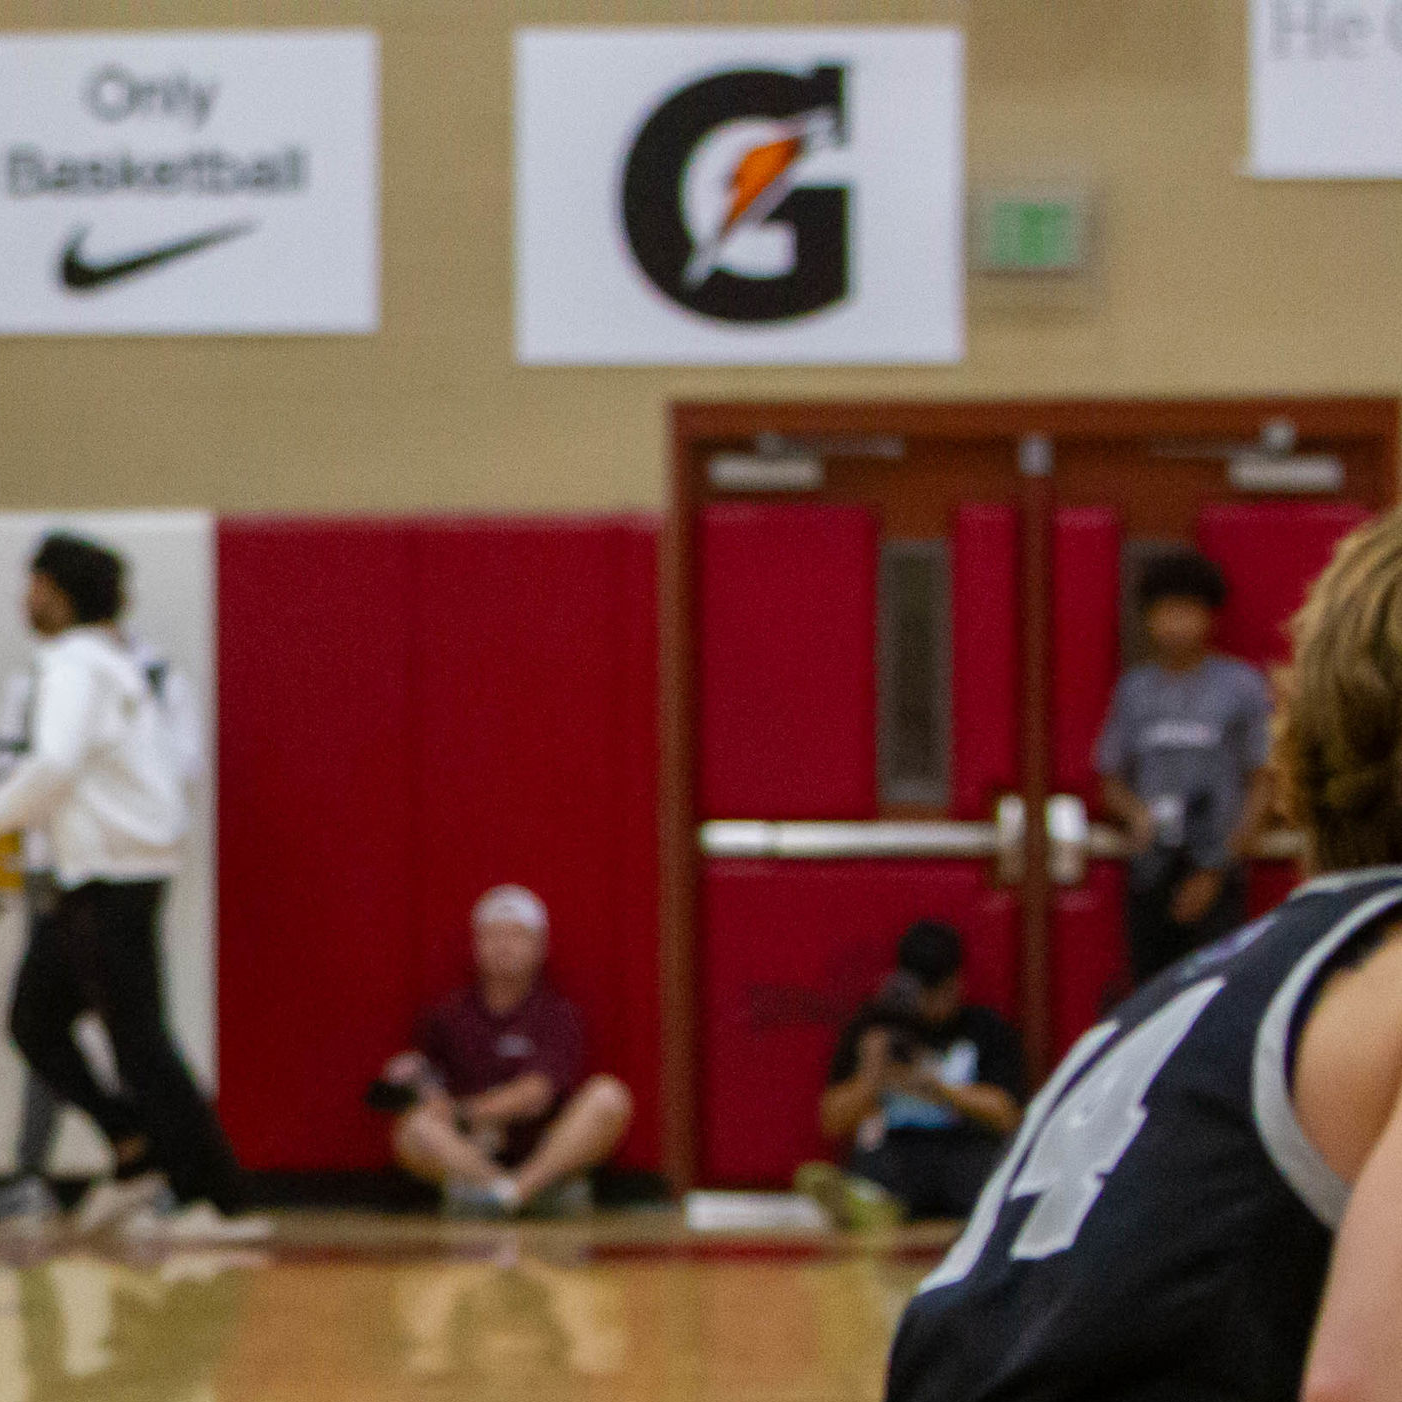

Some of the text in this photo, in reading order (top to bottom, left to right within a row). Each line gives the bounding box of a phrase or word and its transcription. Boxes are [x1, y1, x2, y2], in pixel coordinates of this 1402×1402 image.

[82, 62, 220, 131] Only
[4, 142, 310, 199] Basketball
[620, 60, 853, 325] G
